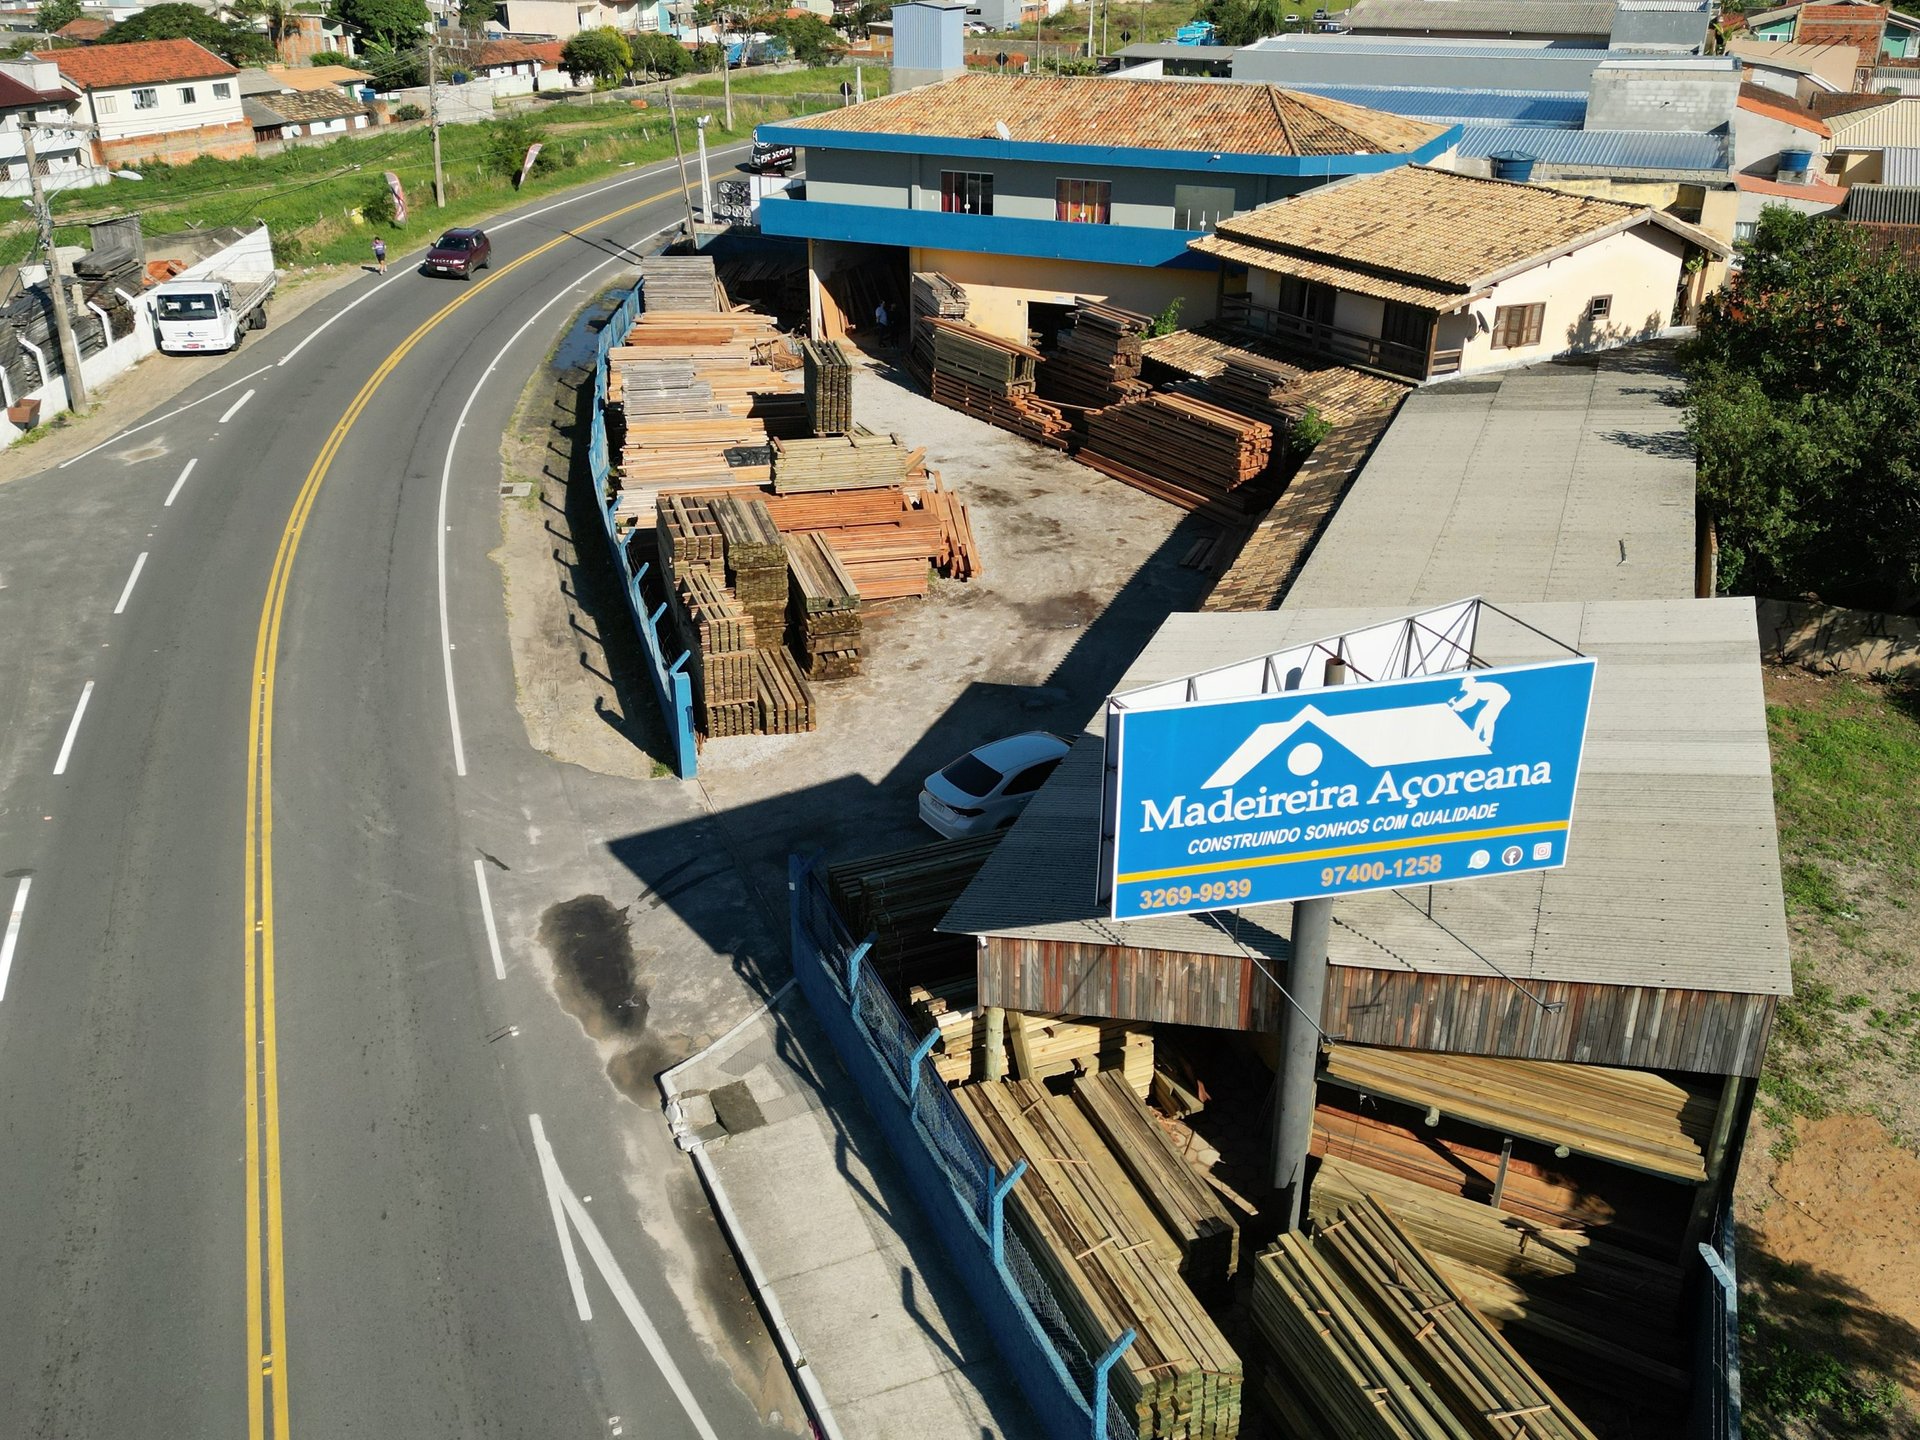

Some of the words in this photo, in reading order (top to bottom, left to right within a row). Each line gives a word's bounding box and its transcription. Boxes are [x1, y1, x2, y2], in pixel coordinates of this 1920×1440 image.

[1140, 780, 1359, 833] Madeireira
[1367, 762, 1552, 809] Açoreana
[1188, 827, 1301, 855] CONSTRUINDO
[1303, 818, 1370, 841] SONHOS
[1373, 814, 1409, 833] COM
[1410, 803, 1500, 828] QUALIDADE
[1321, 855, 1442, 886] 97400-1258
[1140, 878, 1252, 910] 3269-9939
